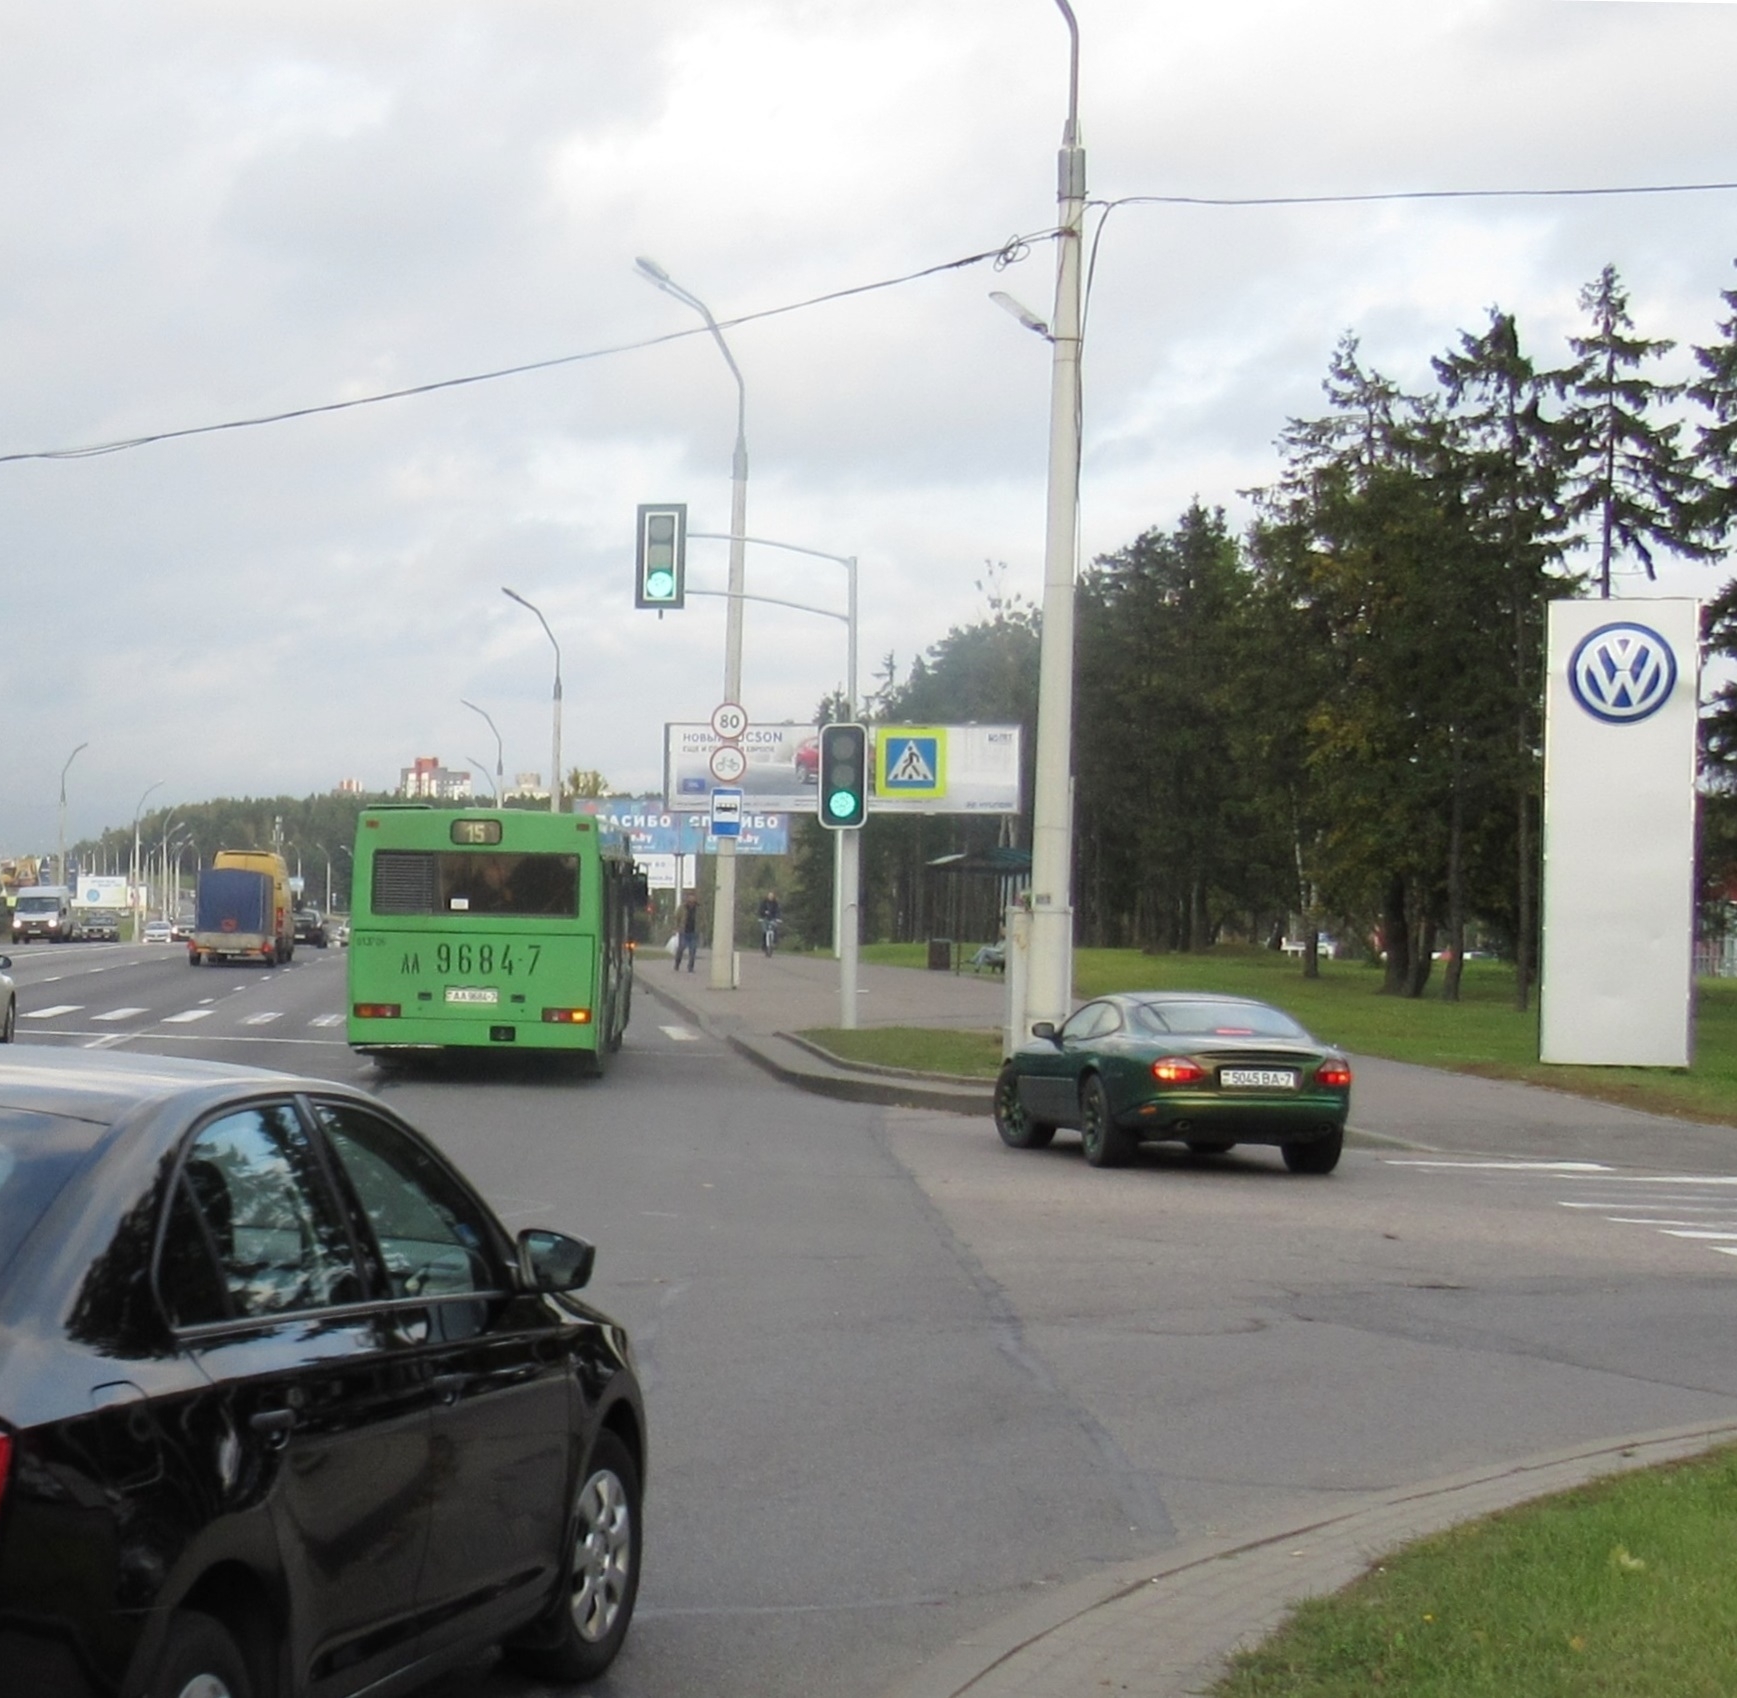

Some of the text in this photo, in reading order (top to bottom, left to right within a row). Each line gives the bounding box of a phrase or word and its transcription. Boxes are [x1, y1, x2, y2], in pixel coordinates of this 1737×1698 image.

[719, 714, 740, 729] 80
[683, 732, 722, 743] НОВЫ
[466, 824, 486, 843] 15
[401, 943, 542, 976] AA 9684-7
[1232, 1072, 1260, 1084] 5045
